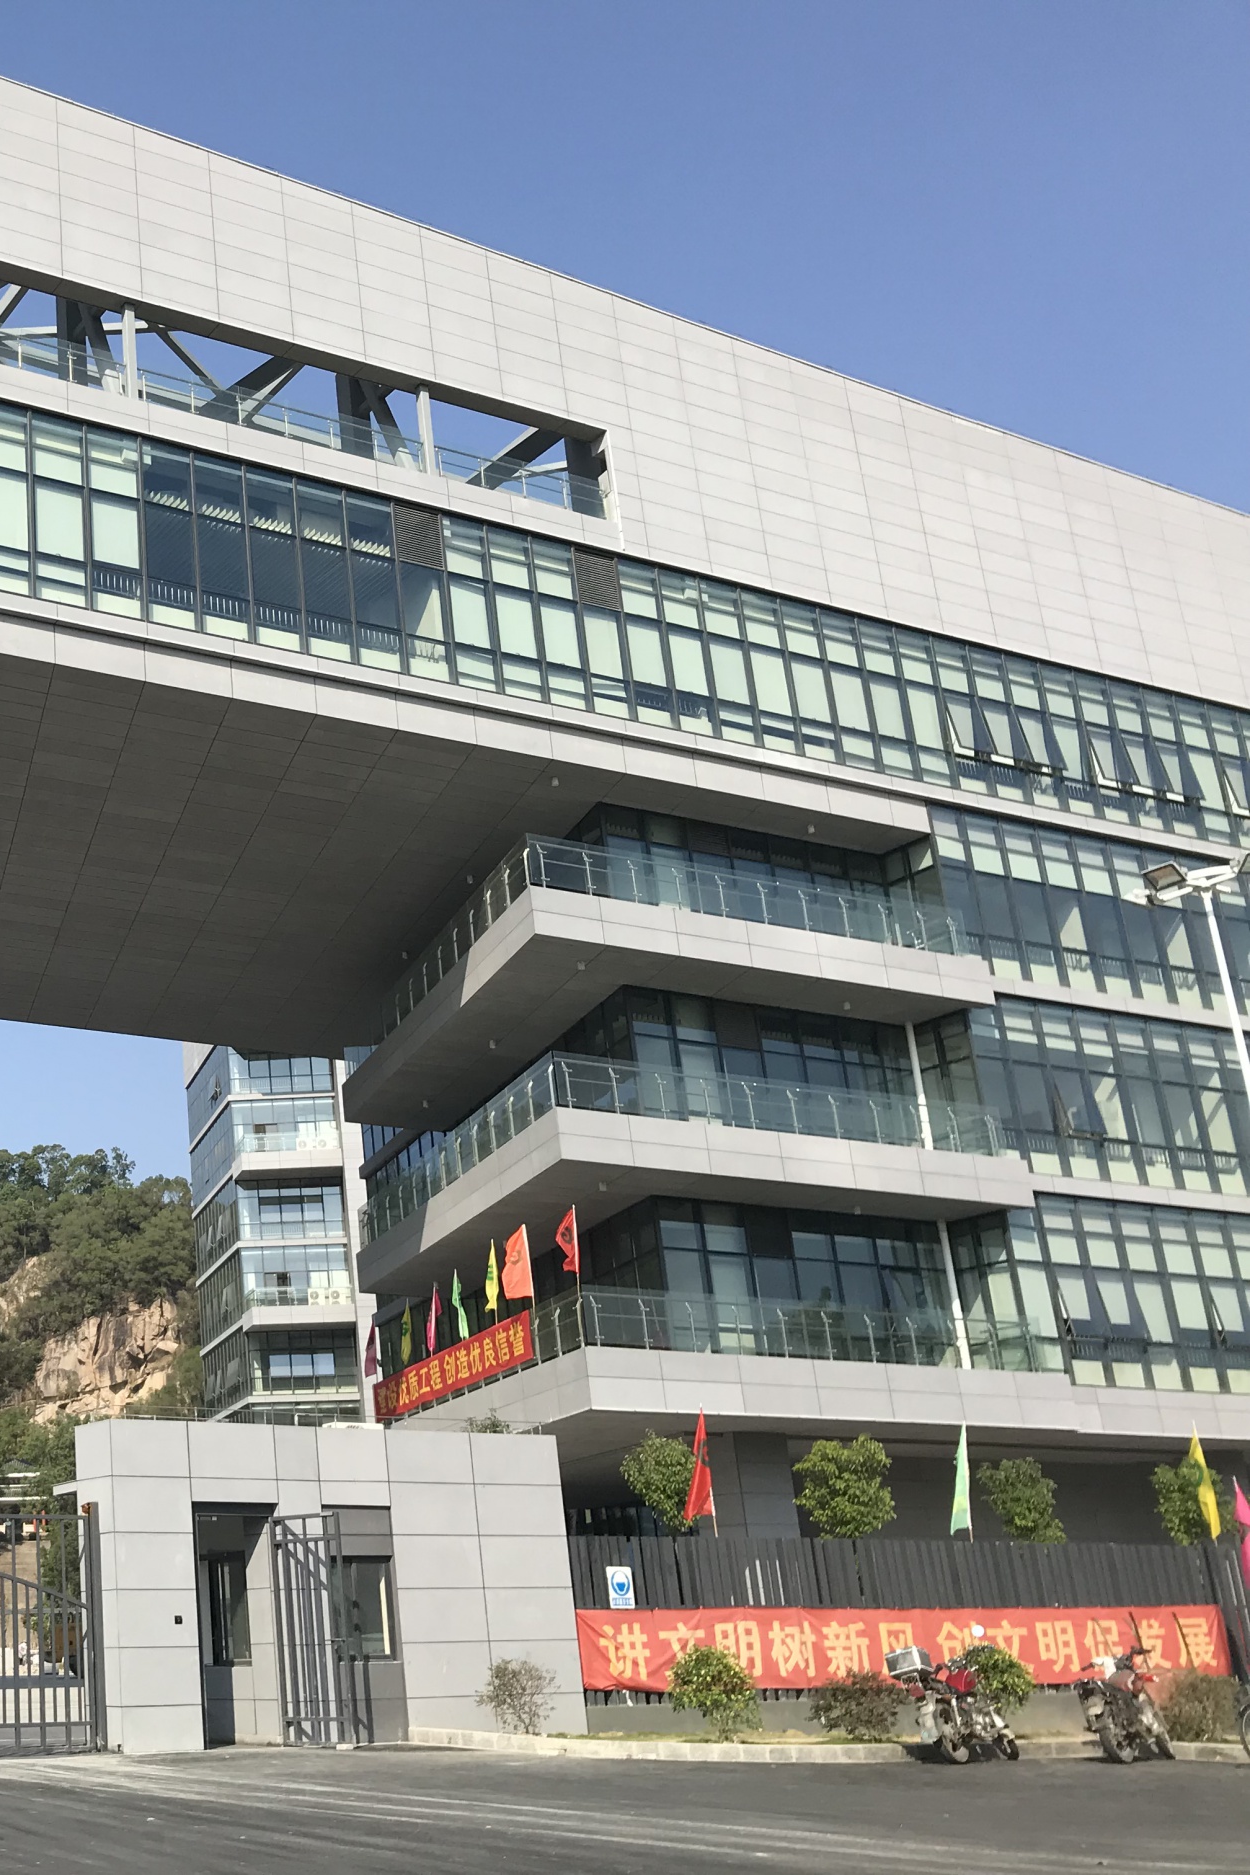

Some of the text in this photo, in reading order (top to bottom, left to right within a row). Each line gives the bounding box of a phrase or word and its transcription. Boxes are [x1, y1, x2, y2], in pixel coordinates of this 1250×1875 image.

[444, 1321, 526, 1385] 创造优良信誉
